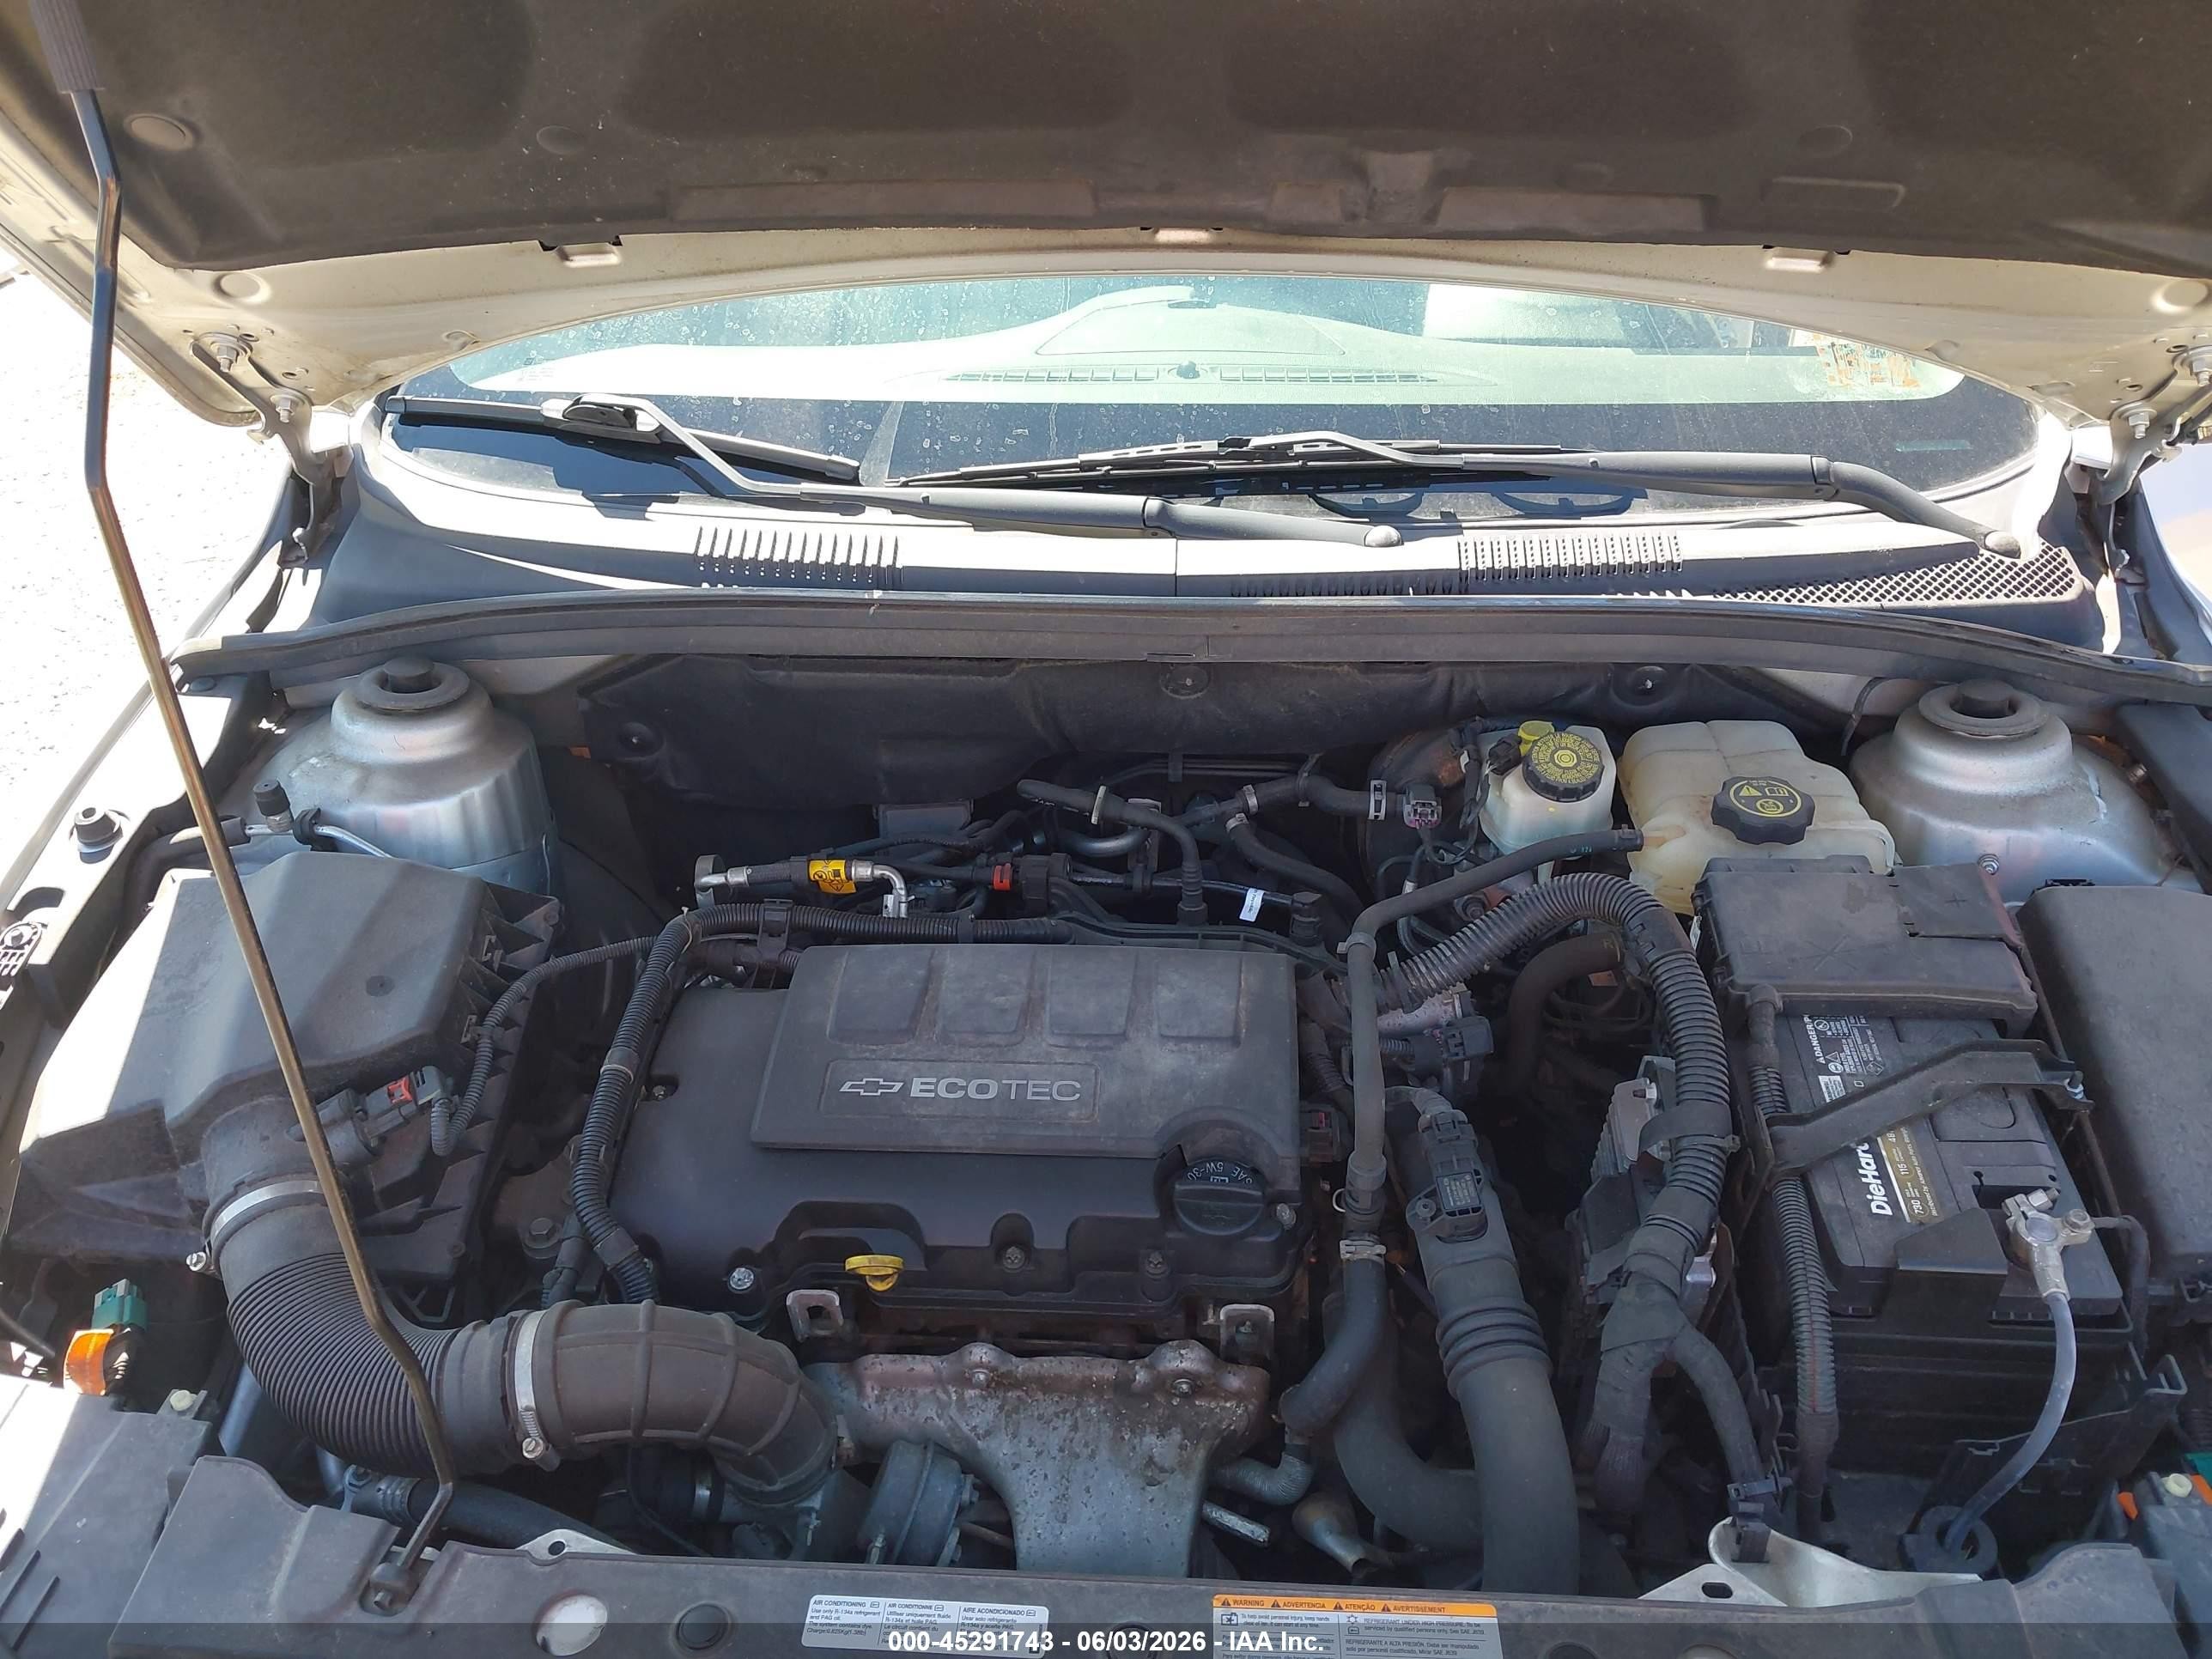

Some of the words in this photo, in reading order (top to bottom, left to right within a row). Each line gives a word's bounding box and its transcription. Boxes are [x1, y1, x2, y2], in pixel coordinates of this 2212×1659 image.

[1803, 1014, 1824, 1057] DANGER/P
[909, 1077, 1082, 1101] ECOTEC
[1187, 1162, 1224, 1181] 5W-30
[1911, 1199, 1924, 1214] 730
[977, 1607, 1025, 1616] ACONDICIONADO
[1393, 1605, 1446, 1613] AVERTISSEMENT
